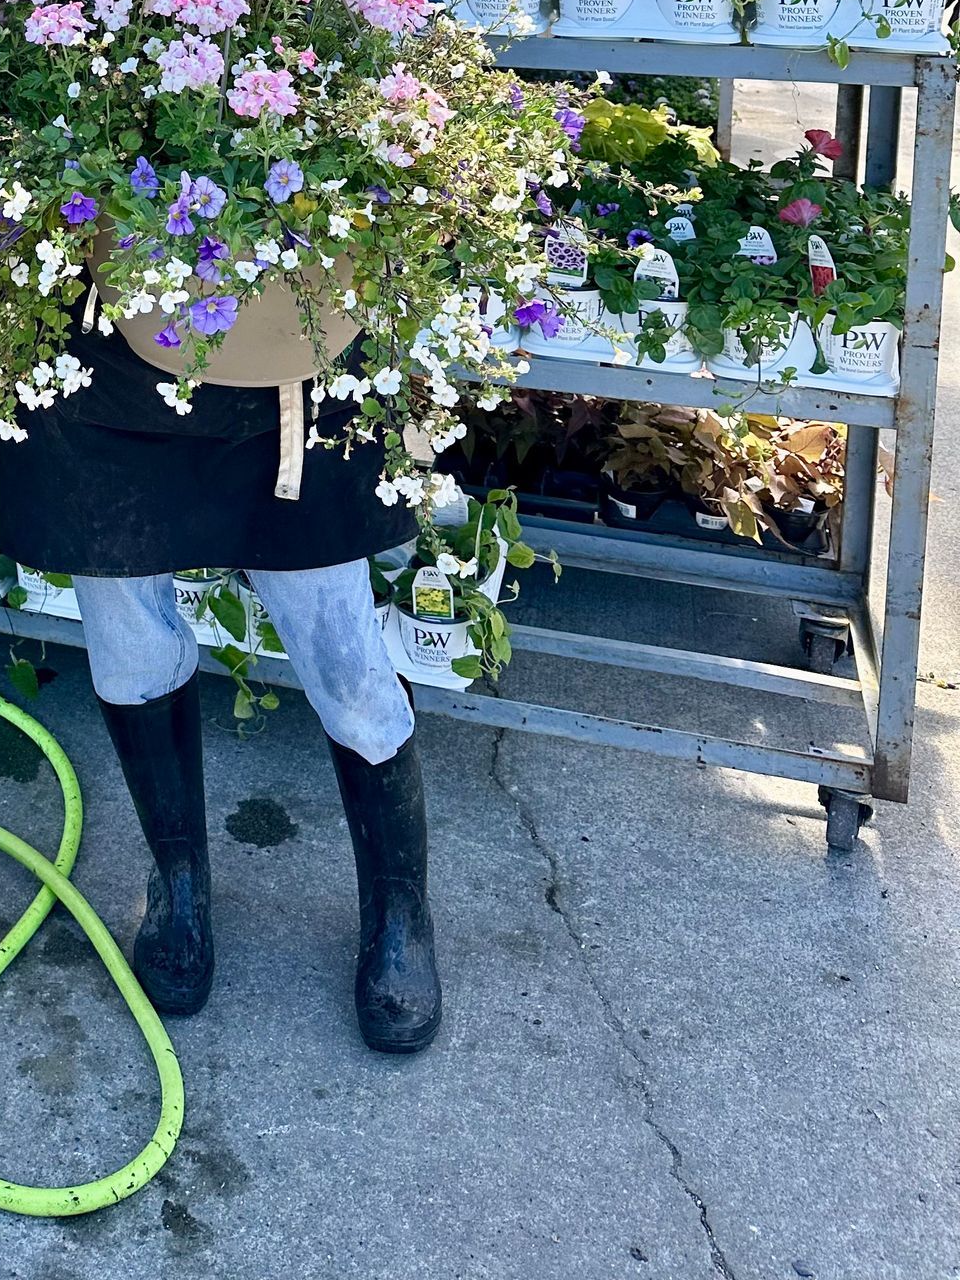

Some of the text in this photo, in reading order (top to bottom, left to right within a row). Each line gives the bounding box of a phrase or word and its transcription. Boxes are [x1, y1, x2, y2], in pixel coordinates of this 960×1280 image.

[475, 2, 509, 10] WINNER
[578, 0, 614, 7] PROVEN
[677, 4, 714, 12] PROVEN
[778, 14, 823, 22] WINNERS
[885, 10, 923, 18] PROVEN
[889, 17, 926, 26] INNERS
[841, 331, 887, 351] PW
[843, 350, 881, 359] PROVEN
[413, 627, 452, 649] PW
[416, 646, 448, 656] PROVEN
